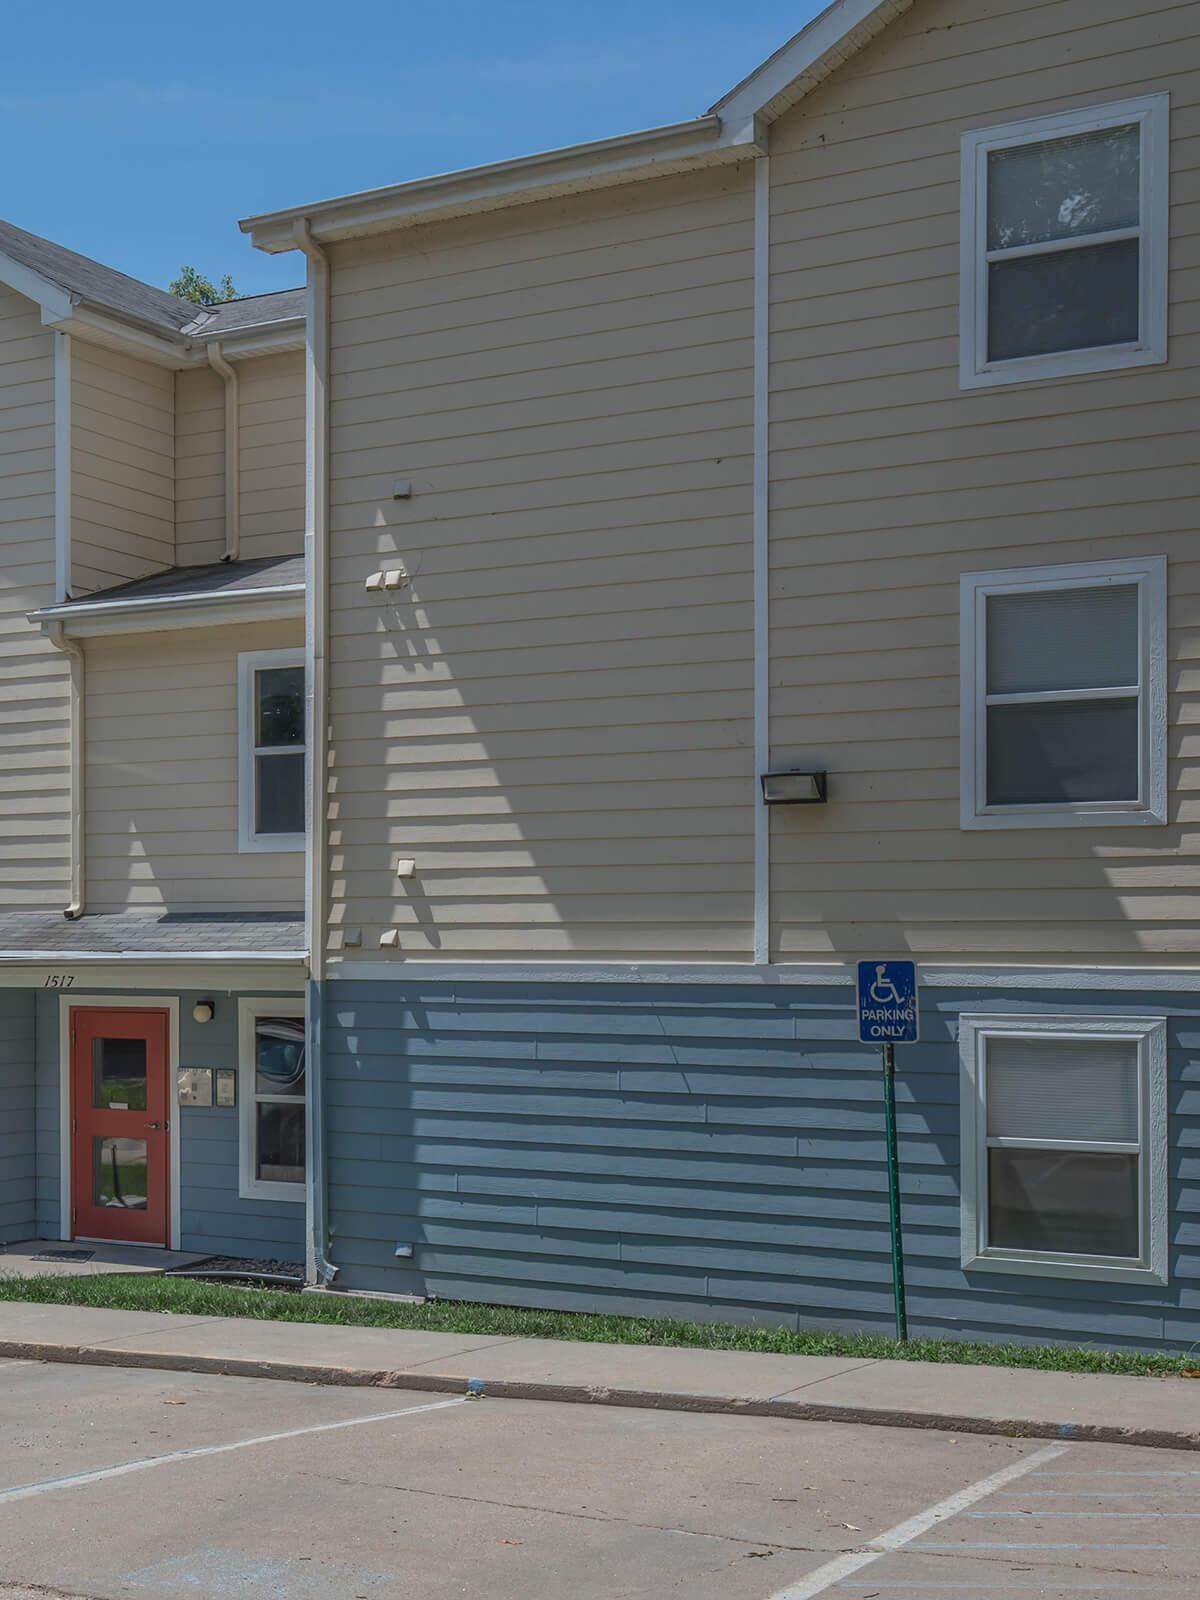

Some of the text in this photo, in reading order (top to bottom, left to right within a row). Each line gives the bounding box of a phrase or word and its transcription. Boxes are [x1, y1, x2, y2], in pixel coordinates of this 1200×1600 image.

[44, 975, 75, 987] 1517
[861, 1009, 914, 1021] PARKING
[870, 1025, 905, 1037] ONLY
